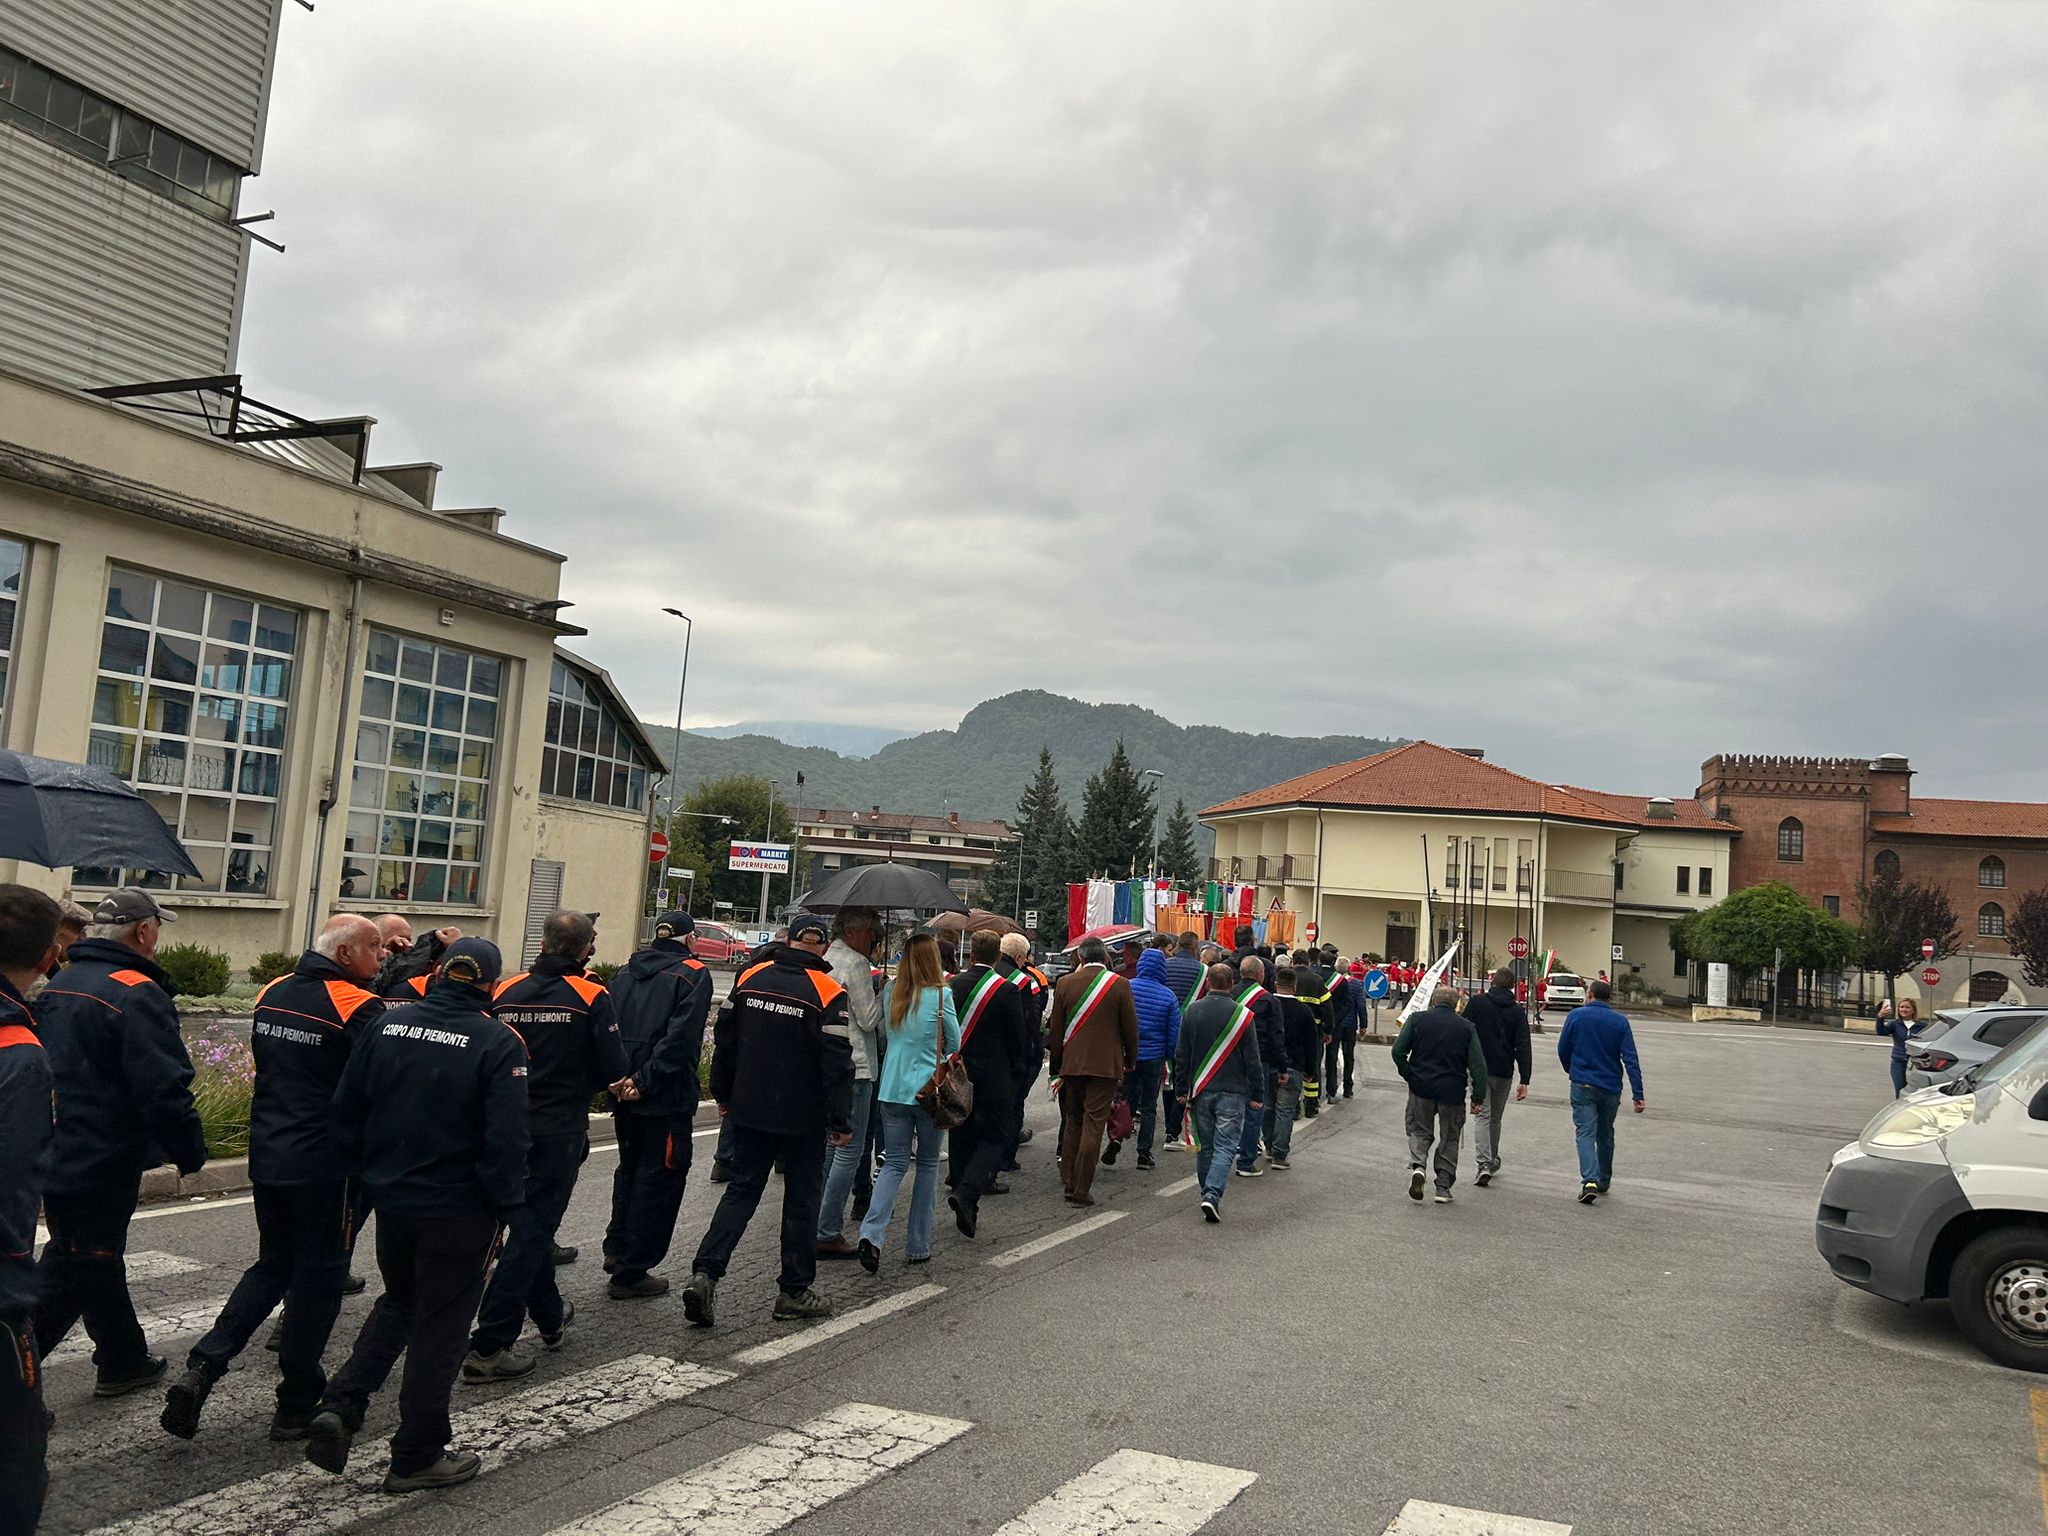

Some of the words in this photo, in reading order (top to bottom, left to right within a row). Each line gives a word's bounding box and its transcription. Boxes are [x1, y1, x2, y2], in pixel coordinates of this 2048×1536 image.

[740, 846, 760, 859] OK
[760, 849, 787, 859] MARKET
[731, 860, 786, 871] SUPERMERCATO
[1508, 943, 1527, 952] STOP
[1922, 972, 1940, 981] STOP
[746, 997, 764, 1010] CORPO
[763, 1001, 776, 1012] AIB
[774, 1003, 805, 1018] PIEMONTE
[519, 1012, 533, 1023] AIB
[533, 1012, 572, 1023] PIEMONTE
[269, 1024, 283, 1038] AIB
[282, 1027, 323, 1046] PIEMONTE
[382, 1023, 409, 1037] CORPO
[406, 1026, 424, 1039] AIB
[422, 1028, 470, 1048] PIEMONTE
